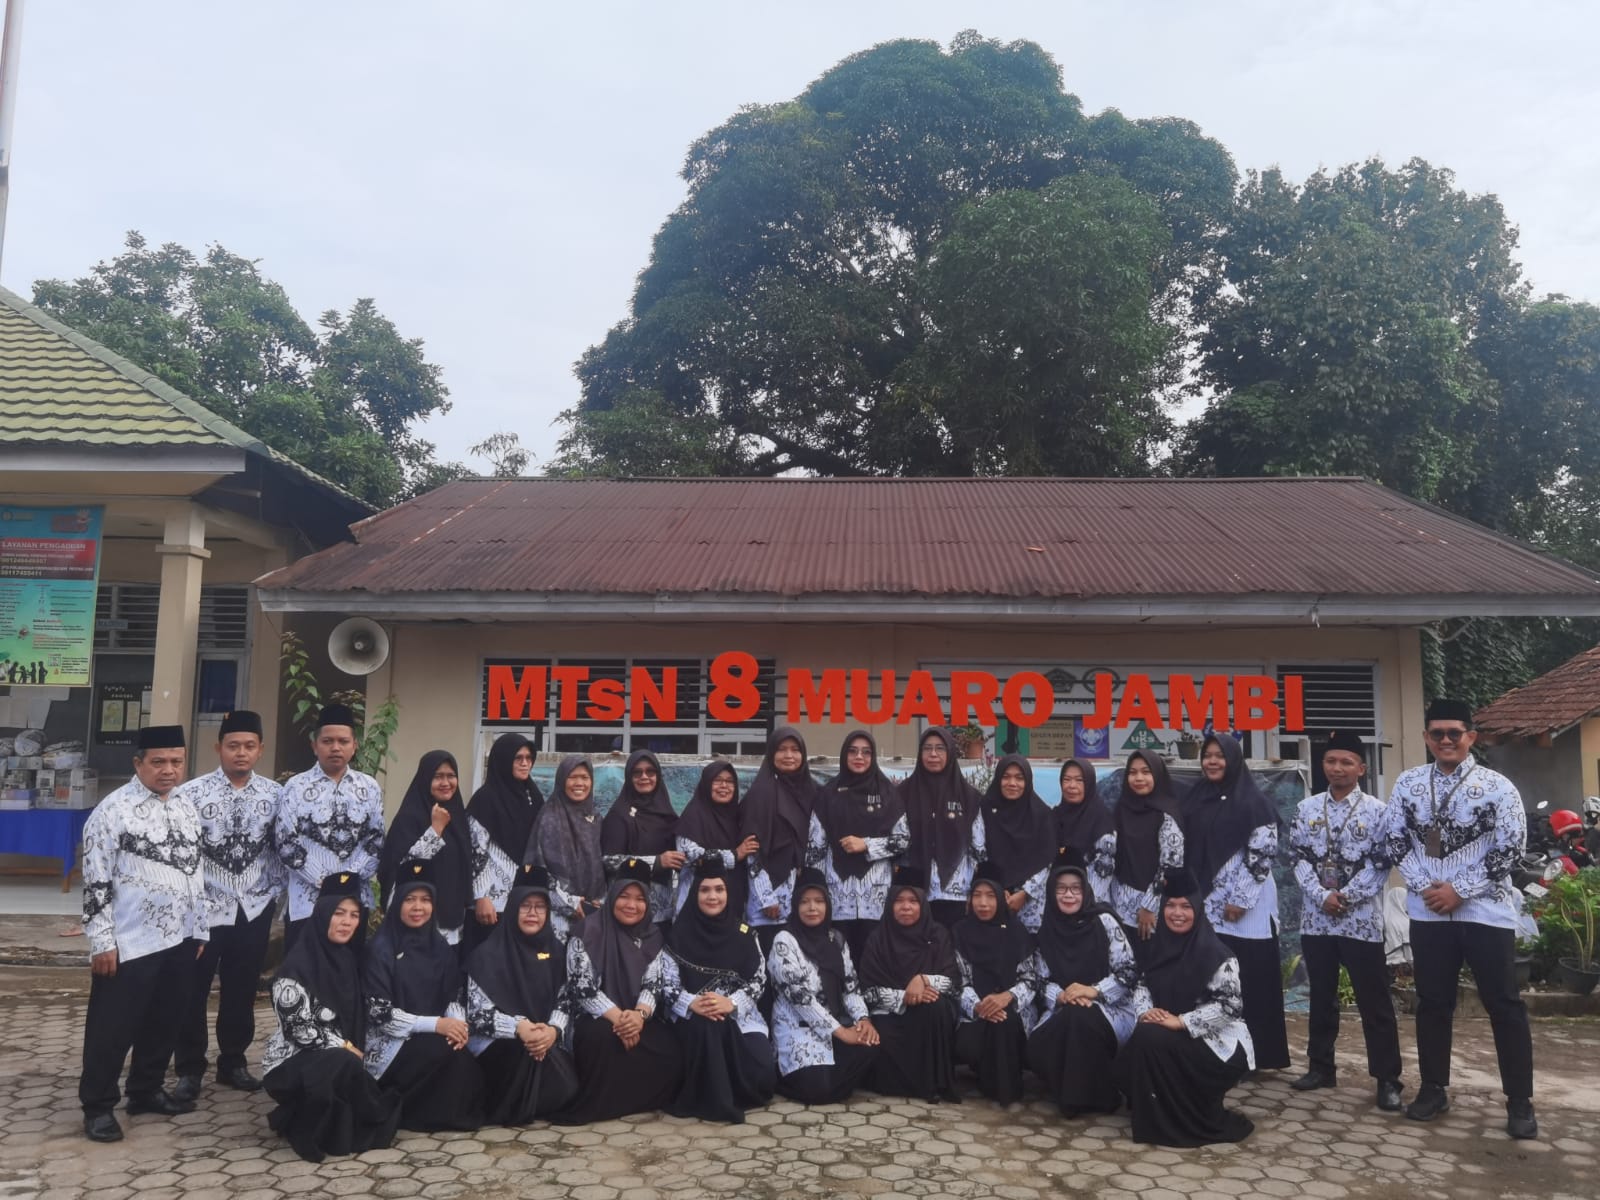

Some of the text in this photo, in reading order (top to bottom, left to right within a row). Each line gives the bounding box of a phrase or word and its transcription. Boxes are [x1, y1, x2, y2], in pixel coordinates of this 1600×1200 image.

[2, 541, 38, 549] LAYANAN
[487, 651, 1305, 732] MTsN 8 MUARO JAMBI
